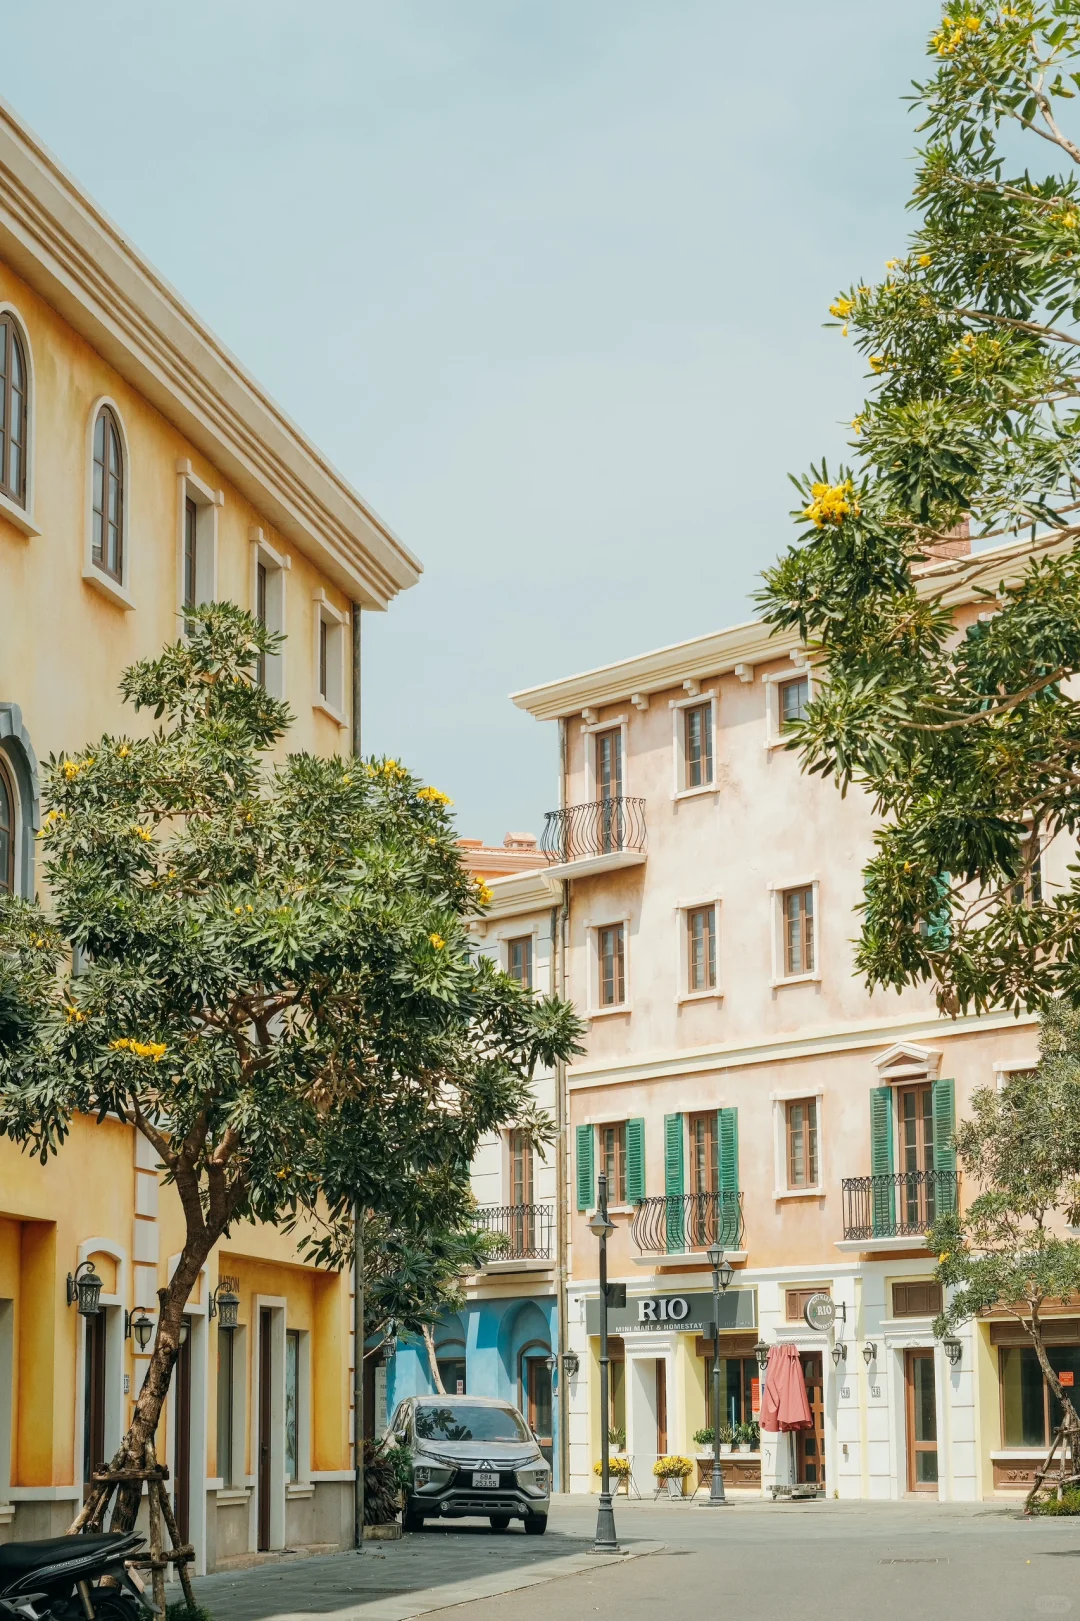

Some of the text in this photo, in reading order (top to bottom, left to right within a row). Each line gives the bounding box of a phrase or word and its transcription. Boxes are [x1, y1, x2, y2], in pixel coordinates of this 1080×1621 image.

[637, 1298, 689, 1321] RIO
[816, 1305, 832, 1316] RIO
[663, 1322, 703, 1330] HOMESTAY
